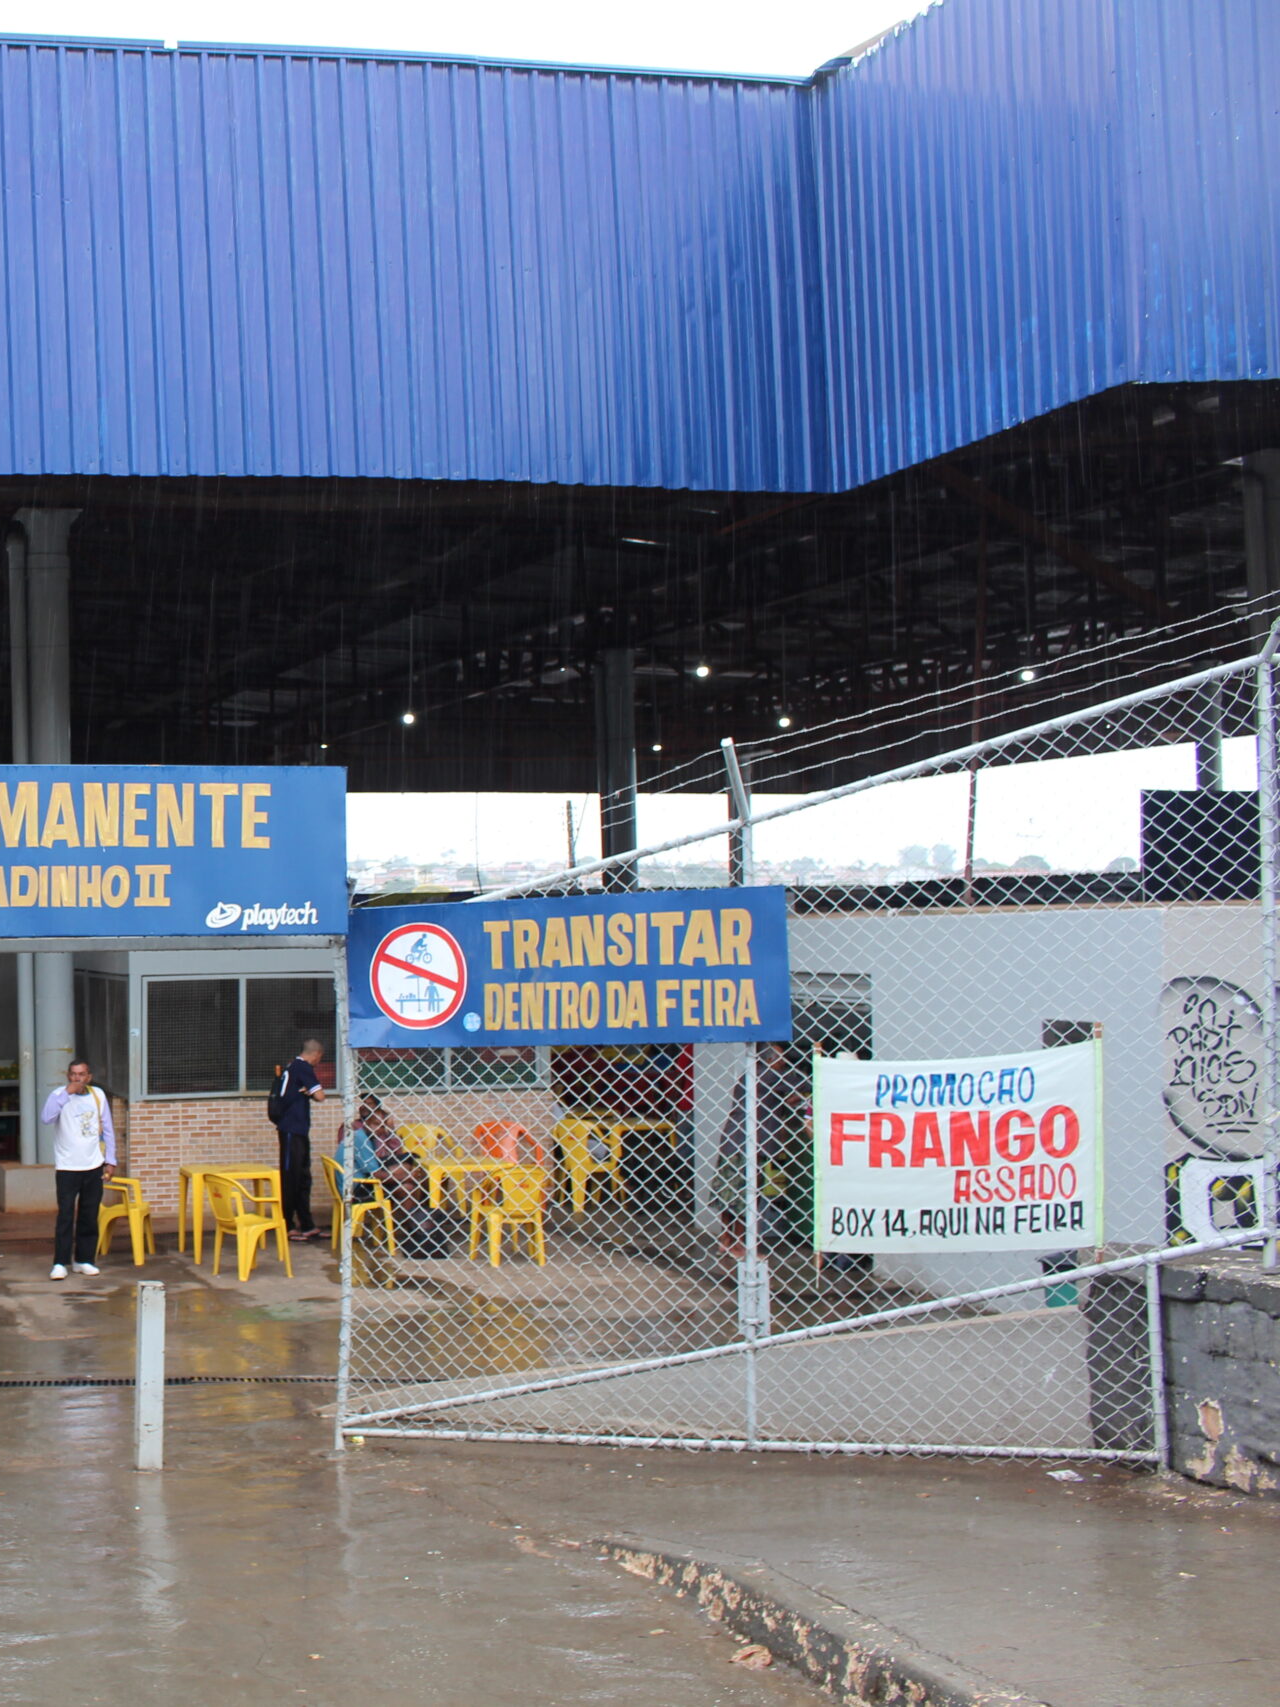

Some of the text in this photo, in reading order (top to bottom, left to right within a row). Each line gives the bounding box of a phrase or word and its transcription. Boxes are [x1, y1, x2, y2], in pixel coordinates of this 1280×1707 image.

[134, 864, 171, 907] II
[241, 900, 318, 931] playtech
[483, 908, 752, 970] TRANSITAR
[483, 979, 761, 1031] DENTRO DA FEIRA
[829, 1104, 1080, 1169] FRANGO
[953, 1163, 1077, 1204] ASSADO
[831, 1206, 876, 1238] BOX
[919, 1207, 970, 1239] AQUI
[975, 1206, 1007, 1236] NA
[1014, 1200, 1085, 1236] FEIRA
